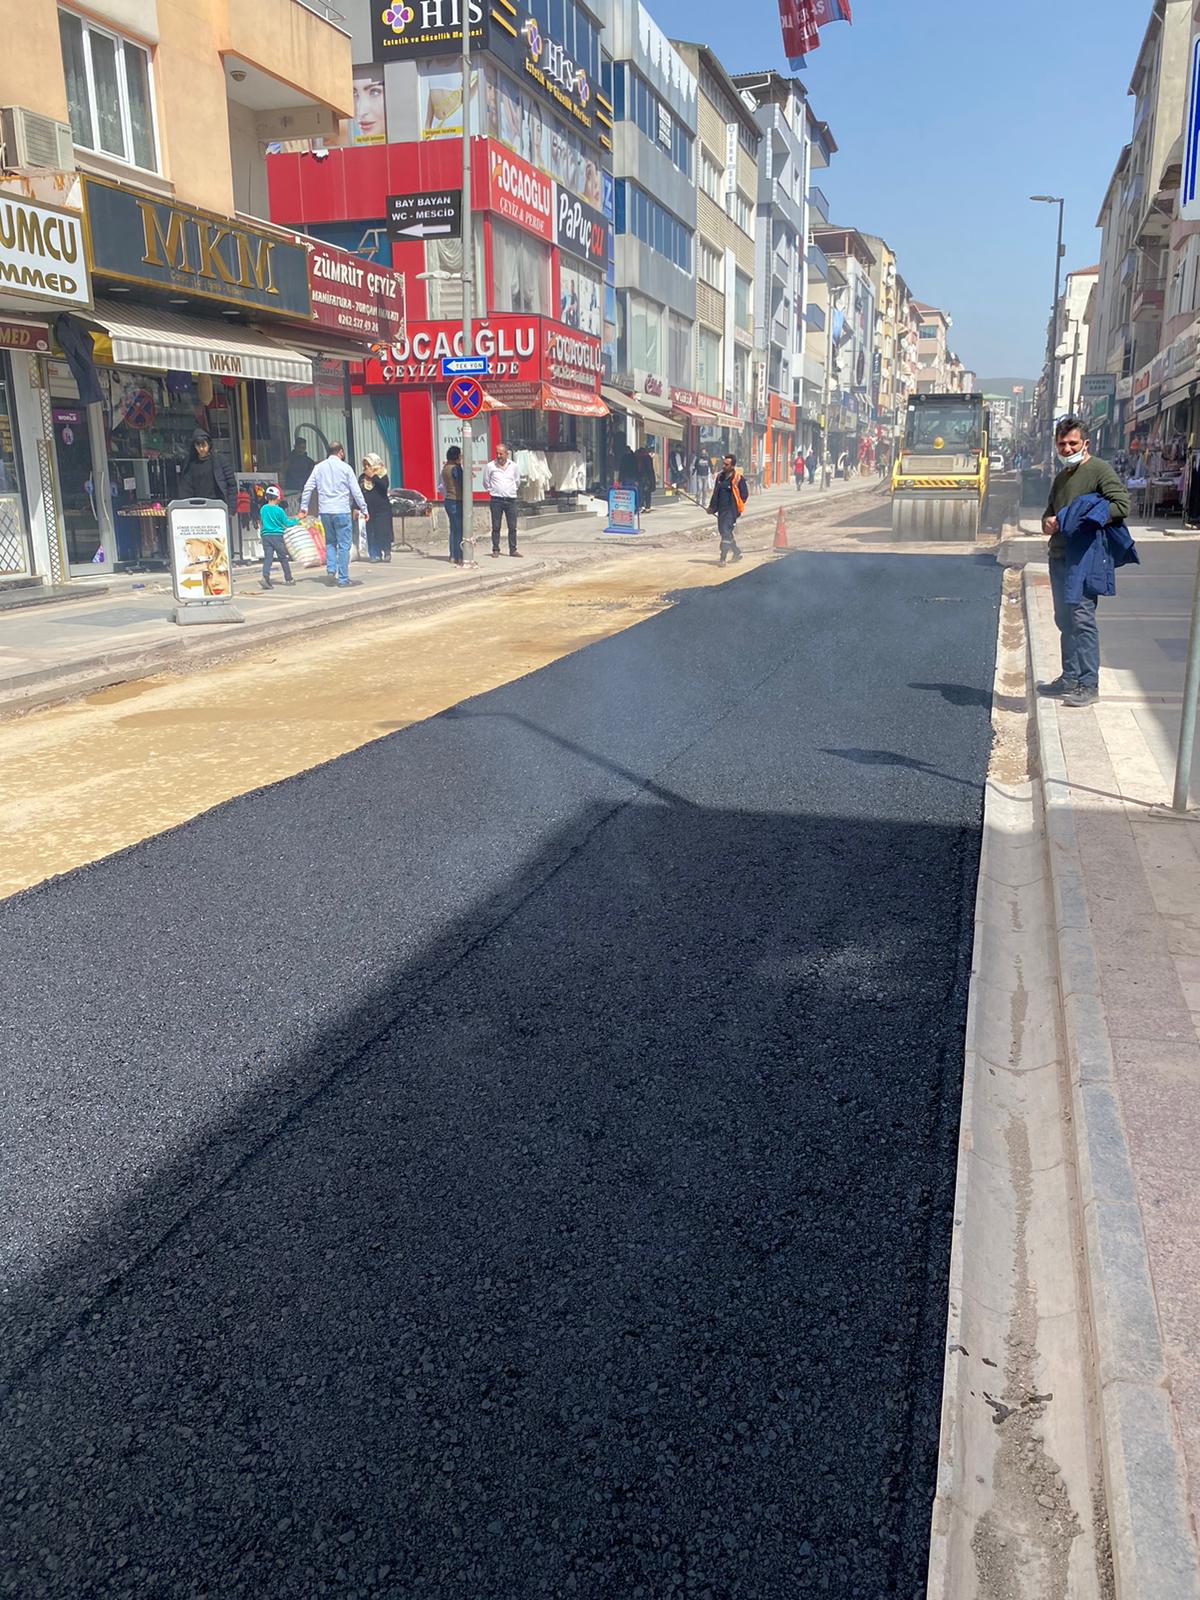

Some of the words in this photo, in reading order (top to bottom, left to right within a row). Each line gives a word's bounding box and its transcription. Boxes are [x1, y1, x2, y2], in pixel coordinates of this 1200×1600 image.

[395, 199, 414, 208] BAY
[417, 196, 451, 206] BAYAN
[391, 212, 408, 221] WC
[416, 207, 455, 219] MESCİD
[136, 200, 280, 295] MKM
[313, 252, 364, 289] ZÜMRÜT
[366, 272, 398, 299] ÇEYİZ
[209, 353, 241, 373] MKM
[456, 362, 468, 370] TEK
[383, 365, 437, 381] ÇEYİZ
